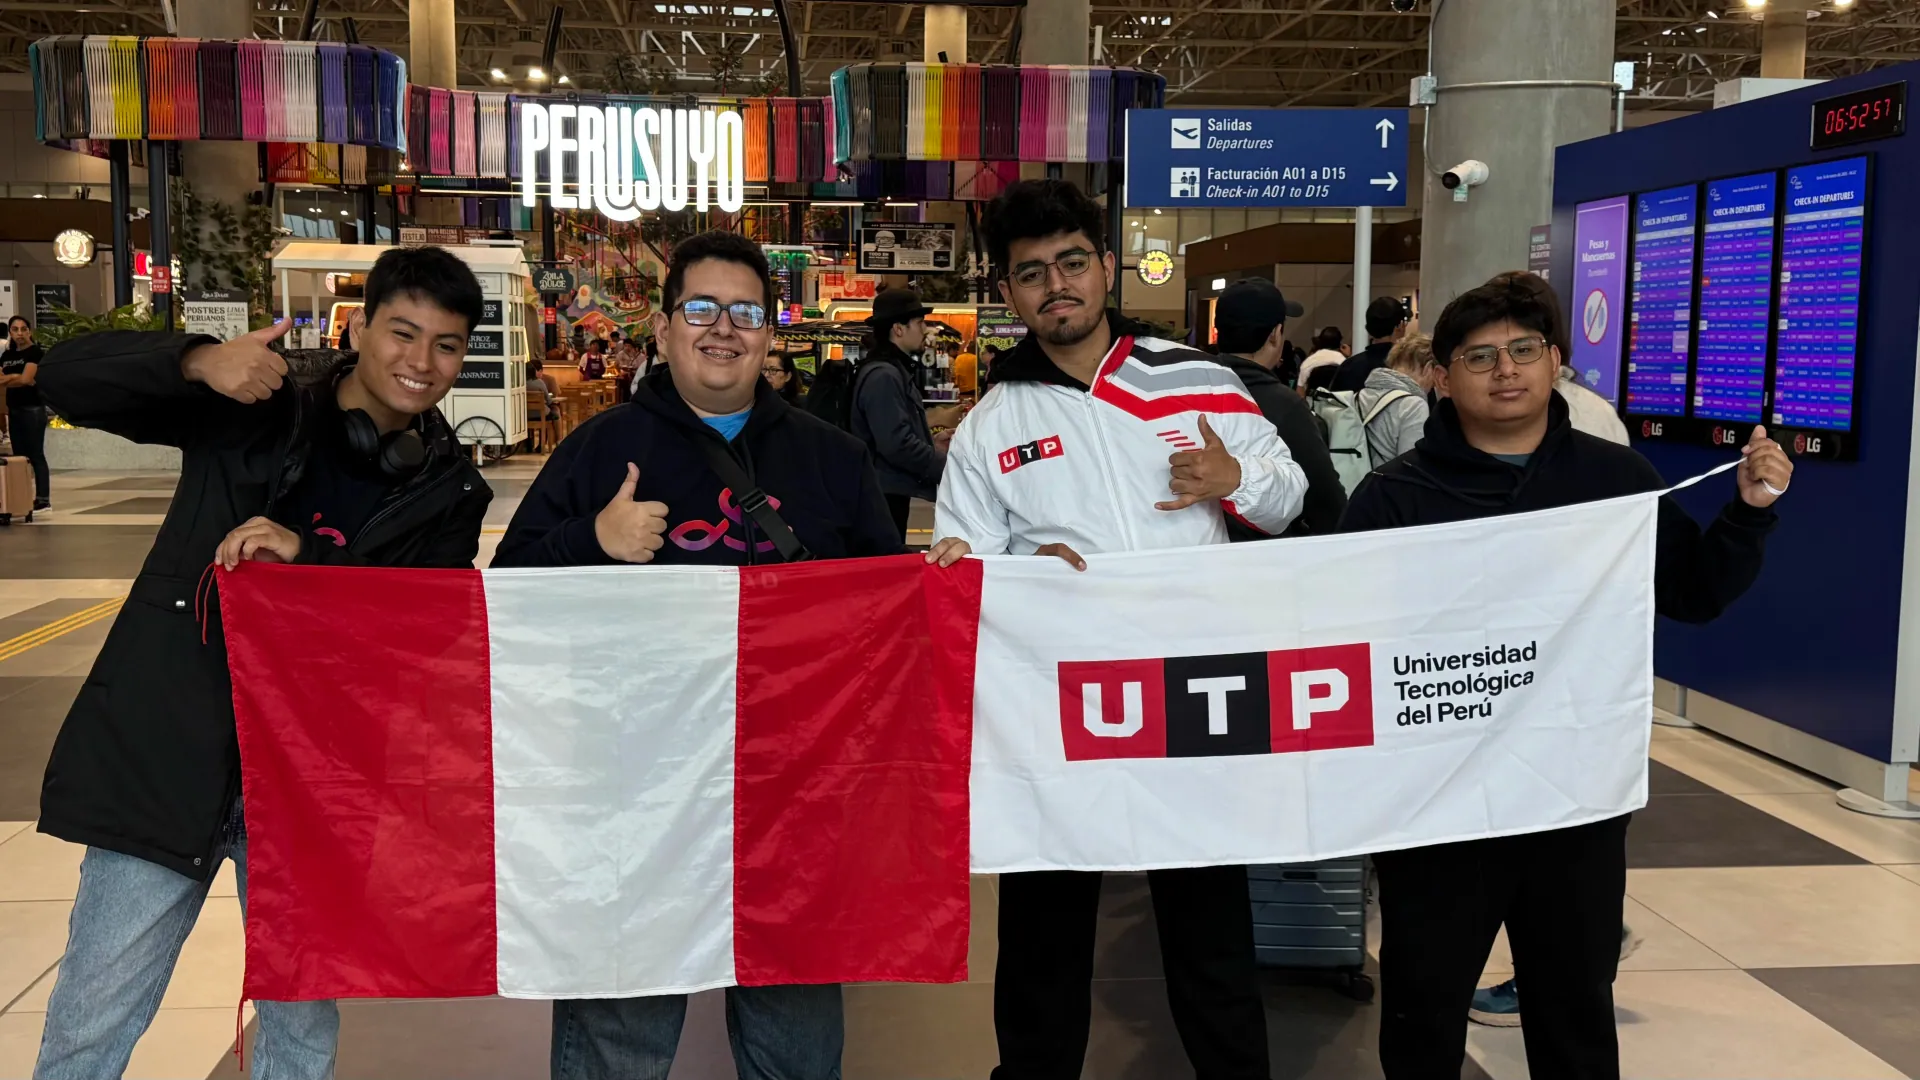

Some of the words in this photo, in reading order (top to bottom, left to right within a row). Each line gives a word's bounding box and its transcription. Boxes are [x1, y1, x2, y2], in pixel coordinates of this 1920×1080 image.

[1825, 103, 1869, 134] 06:52
[1873, 98, 1891, 120] 57
[1207, 118, 1252, 131] Salidas
[1207, 136, 1274, 151] Departures
[521, 103, 744, 221] PERUSUYO
[1207, 167, 1278, 180] Facturación
[1282, 168, 1306, 180] A01
[1310, 170, 1318, 180] a
[1322, 168, 1346, 180] D15
[1206, 185, 1259, 198] Check-in
[1262, 186, 1285, 198] A01
[1289, 186, 1302, 198] to
[1305, 186, 1330, 198] D15
[1793, 195, 1819, 206] CHECK-IN
[1819, 191, 1854, 203] DEPARTURES
[1713, 207, 1735, 217] CHECK-IN
[1735, 203, 1766, 214] DEPARTURES
[1661, 213, 1688, 224] DEPARTURES
[542, 271, 564, 280] ZOILA
[539, 279, 566, 290] DULCE
[186, 306, 225, 314] POSTRES
[469, 335, 491, 343] RROZ
[1001, 440, 1058, 469] UTP
[1393, 640, 1537, 676] Universidad
[1393, 669, 1535, 701] Tecnológica
[1081, 667, 1350, 738] UTP
[1396, 703, 1432, 727] del
[1437, 697, 1492, 723] Perú
